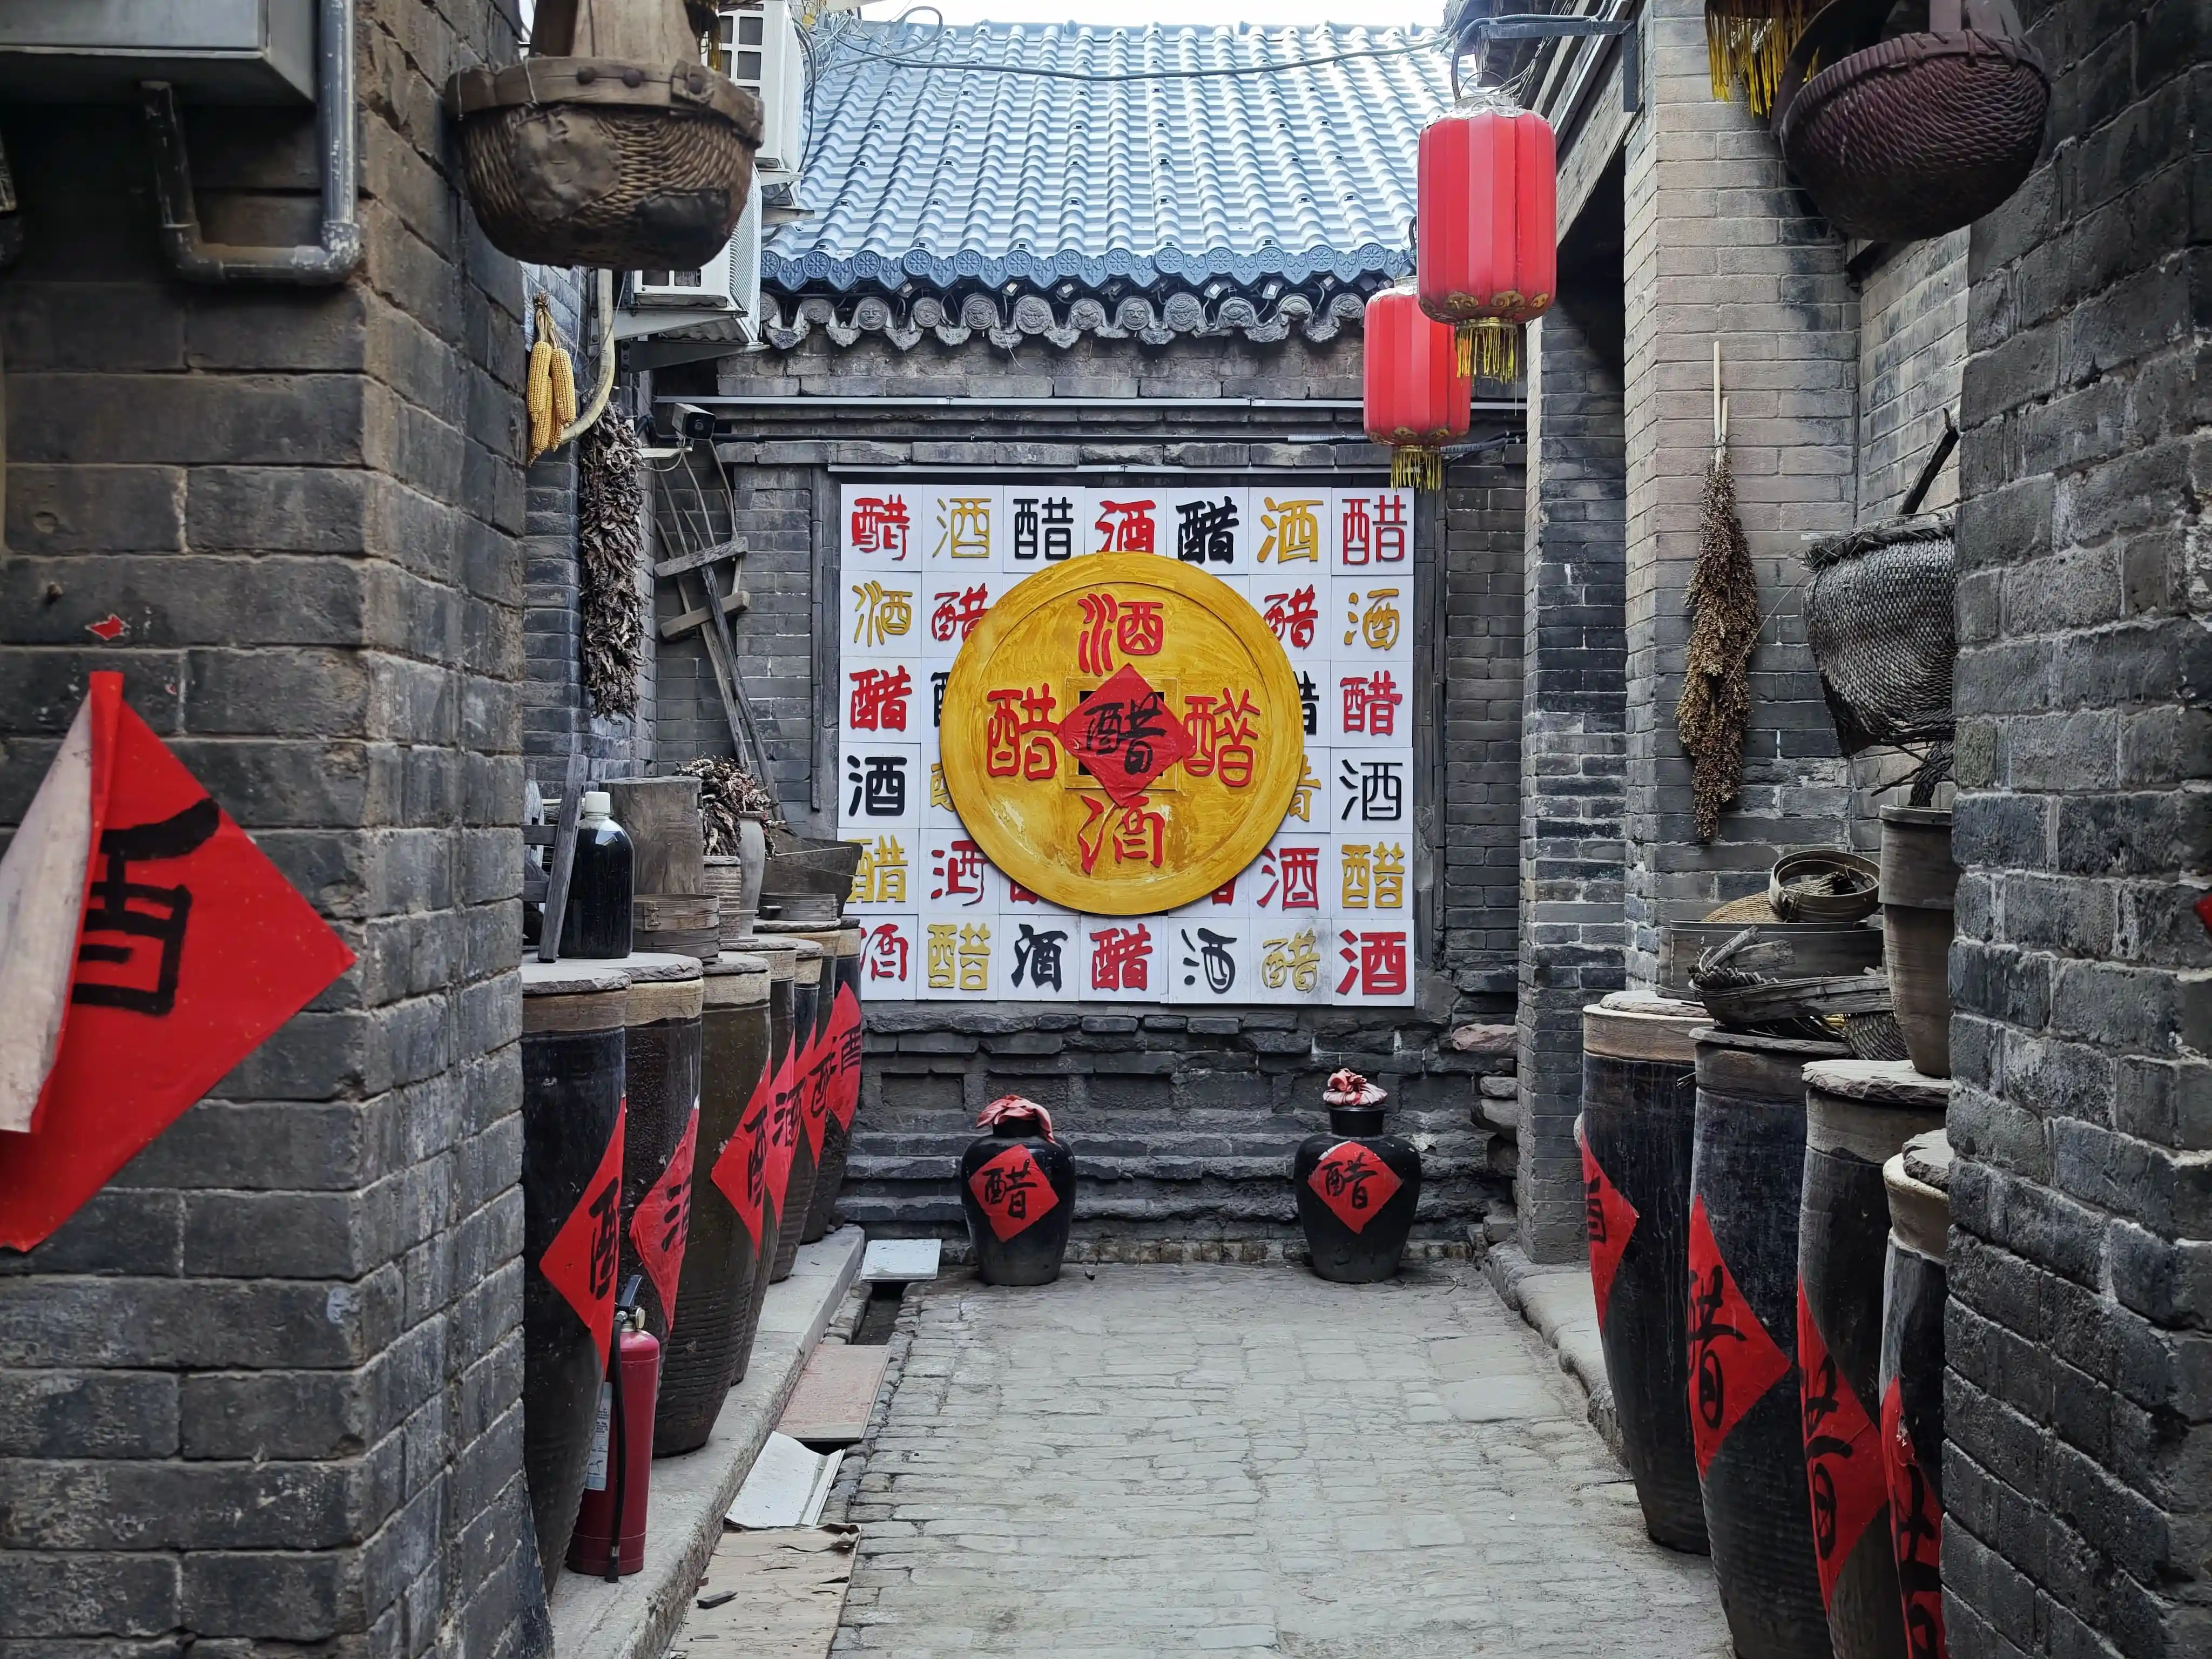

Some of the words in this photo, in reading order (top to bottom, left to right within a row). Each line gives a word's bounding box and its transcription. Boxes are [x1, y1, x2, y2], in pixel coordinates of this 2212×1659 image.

[852, 494, 910, 561] 醋
[932, 498, 992, 558] 酒
[1013, 496, 1075, 561] 醋
[1094, 500, 1156, 554] 酒
[1175, 496, 1239, 564] 醋
[1257, 496, 1324, 564] 酒
[1341, 495, 1407, 565] 醋
[852, 580, 913, 647] 酒
[931, 583, 990, 642] 醋
[1077, 592, 1164, 676] 酒
[1264, 584, 1319, 651] 醋
[1344, 588, 1400, 650] 酒
[849, 665, 913, 732] 醋
[986, 683, 1060, 781] 醋
[1083, 692, 1168, 775] 醋
[1340, 670, 1403, 736] 醋
[1183, 687, 1261, 787] 醋
[847, 755, 908, 817] 酒
[1339, 759, 1403, 821] 酒
[846, 834, 908, 903] 醋
[930, 840, 989, 906] 酒
[1077, 795, 1165, 875] 酒
[1256, 848, 1320, 911] 酒
[1341, 841, 1405, 908] 醋
[861, 923, 908, 981] 酒
[927, 922, 991, 990] 醋
[1010, 923, 1069, 992] 酒
[1090, 922, 1154, 992] 醋
[1181, 927, 1238, 994] 酒
[1262, 927, 1320, 994] 醋
[1335, 929, 1407, 995] 酒
[982, 1158, 1037, 1220] 醋
[1321, 1152, 1378, 1209] 醋
